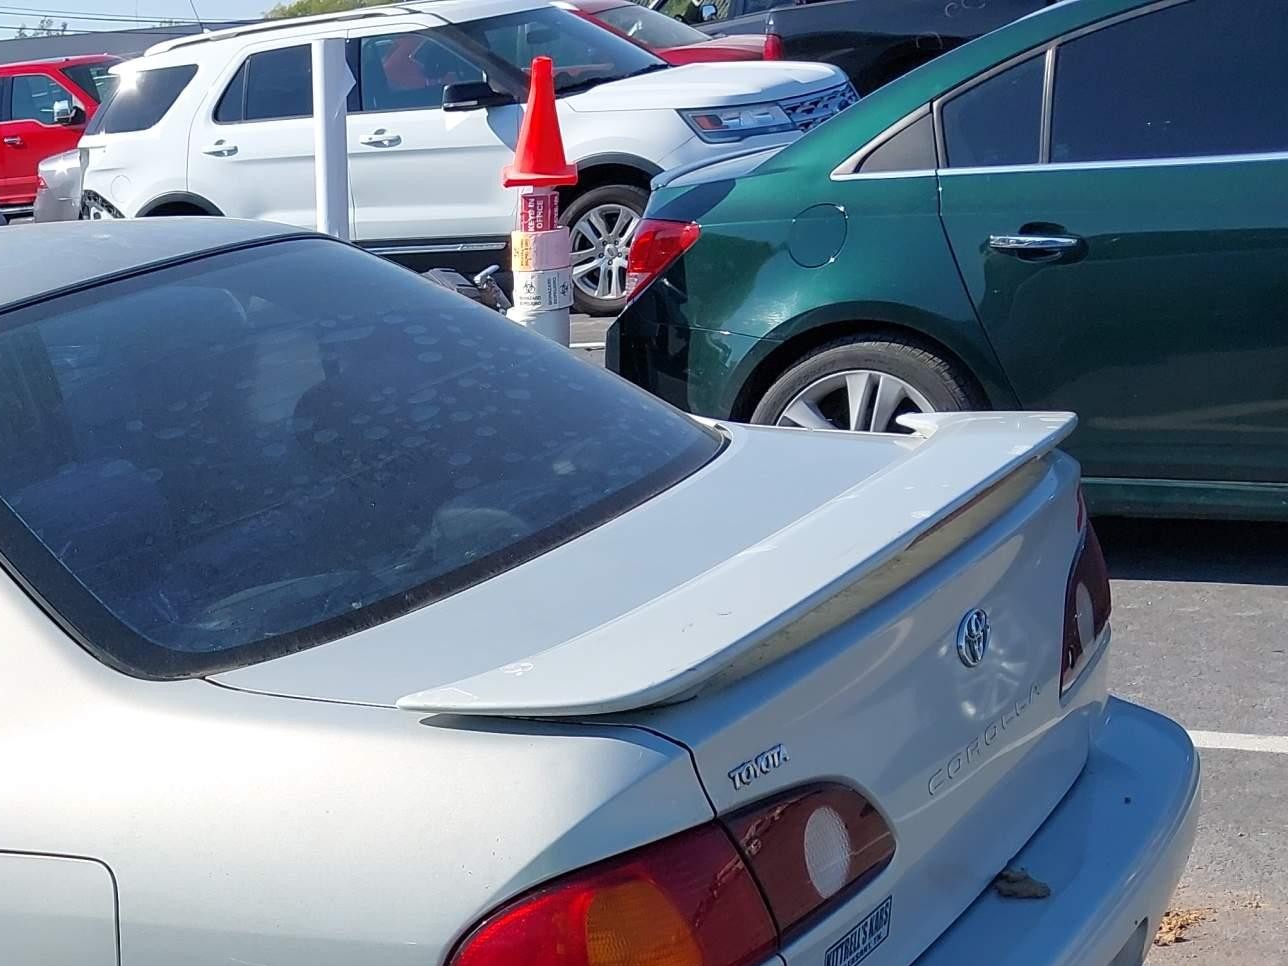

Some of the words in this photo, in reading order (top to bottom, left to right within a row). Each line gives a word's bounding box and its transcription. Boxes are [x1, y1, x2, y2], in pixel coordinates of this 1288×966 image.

[527, 197, 536, 208] IN
[536, 199, 544, 229] OFFICE
[527, 209, 536, 232] KEYS
[928, 681, 1041, 796] COROLLA
[727, 743, 790, 791] TOYOTA
